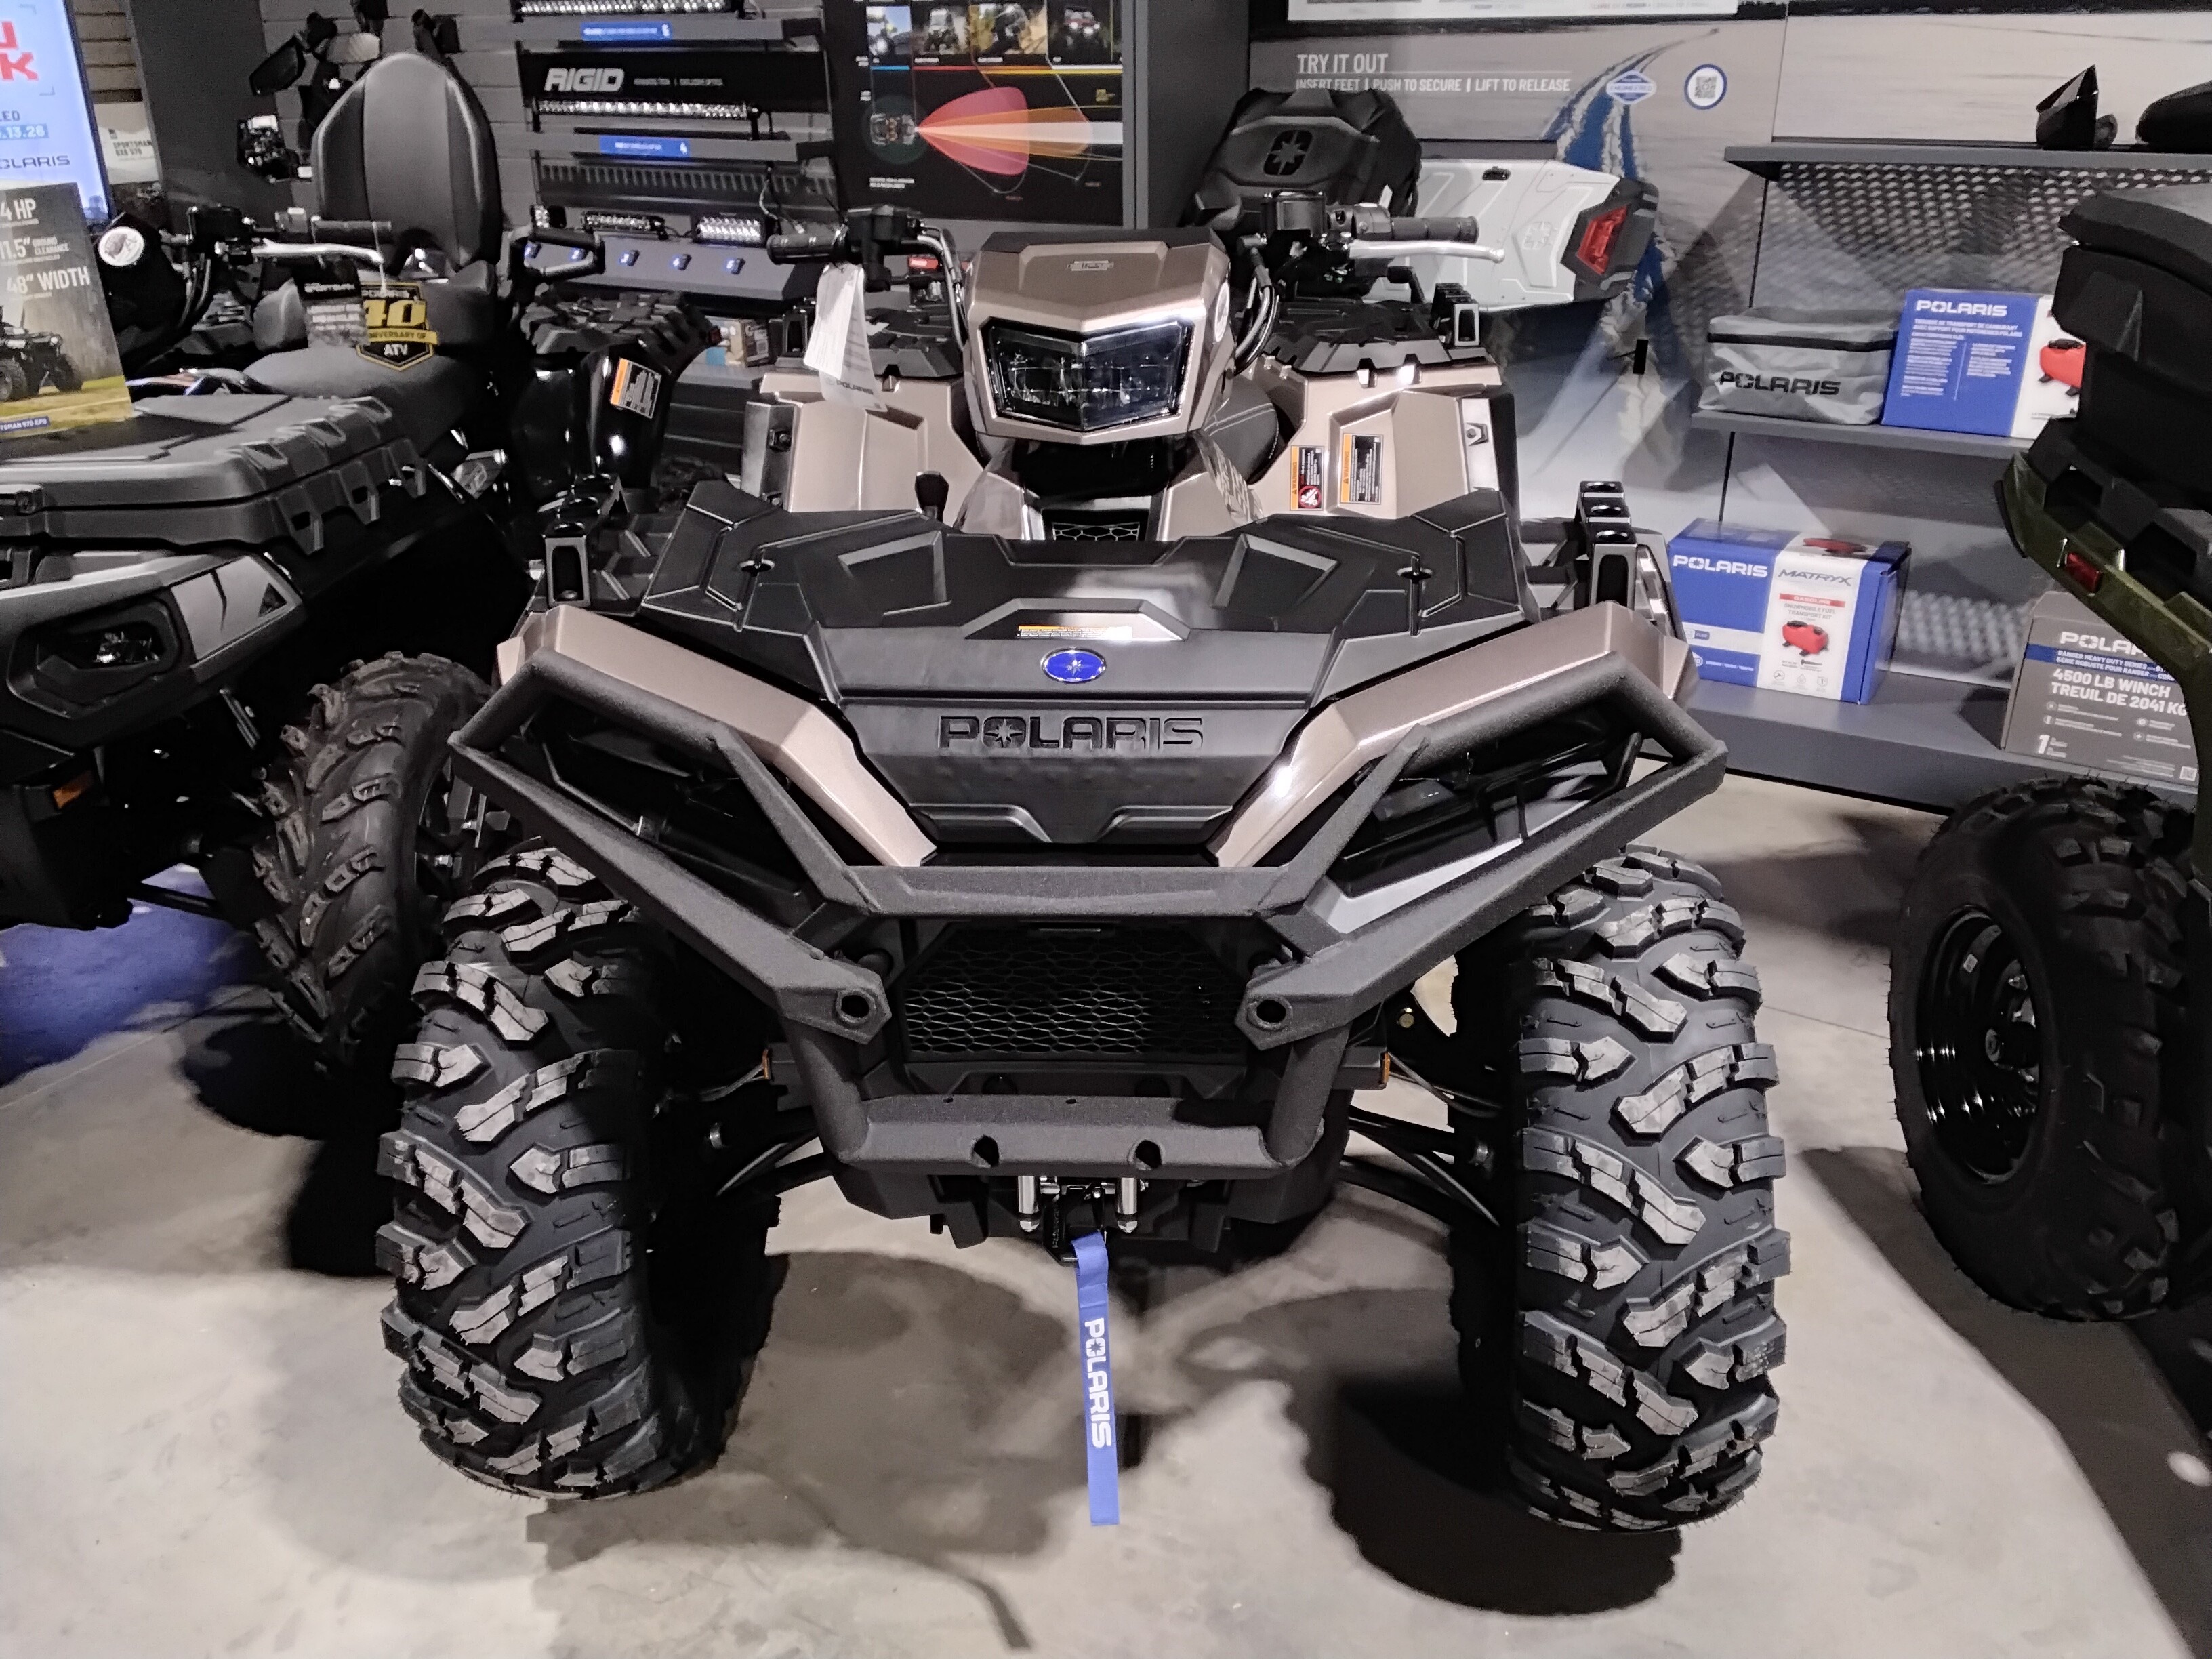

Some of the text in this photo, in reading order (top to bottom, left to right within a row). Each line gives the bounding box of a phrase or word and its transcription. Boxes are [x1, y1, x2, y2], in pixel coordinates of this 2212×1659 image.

[1296, 53, 1389, 74] TRY IT OUT
[544, 68, 625, 92] RIGID
[1334, 79, 1360, 91] FEET
[1373, 79, 1401, 91] PUSH
[1404, 79, 1418, 91] TO
[1419, 79, 1462, 91] SECURE
[1475, 79, 1500, 91] LIFT
[1502, 79, 1517, 91] TO
[1519, 79, 1572, 92] RELEASE
[14, 198, 37, 220] HP
[37, 266, 90, 291] WIDTH
[1916, 300, 2008, 316] POLARIS
[384, 344, 408, 356] ATV
[836, 379, 874, 395] POLARIS
[1719, 371, 1841, 396] POLARIS
[1673, 554, 1769, 577] POLARIS
[1778, 569, 1852, 586] MATRYX
[1793, 596, 1831, 605] GASOLINE
[2053, 668, 2171, 698] 4500 LB WINCH
[2051, 682, 2188, 716] TREUIL DE 2041 KG
[939, 716, 1204, 750] POLARIS
[2039, 734, 2050, 754] 1
[1084, 1317, 1112, 1448] POLARIS
